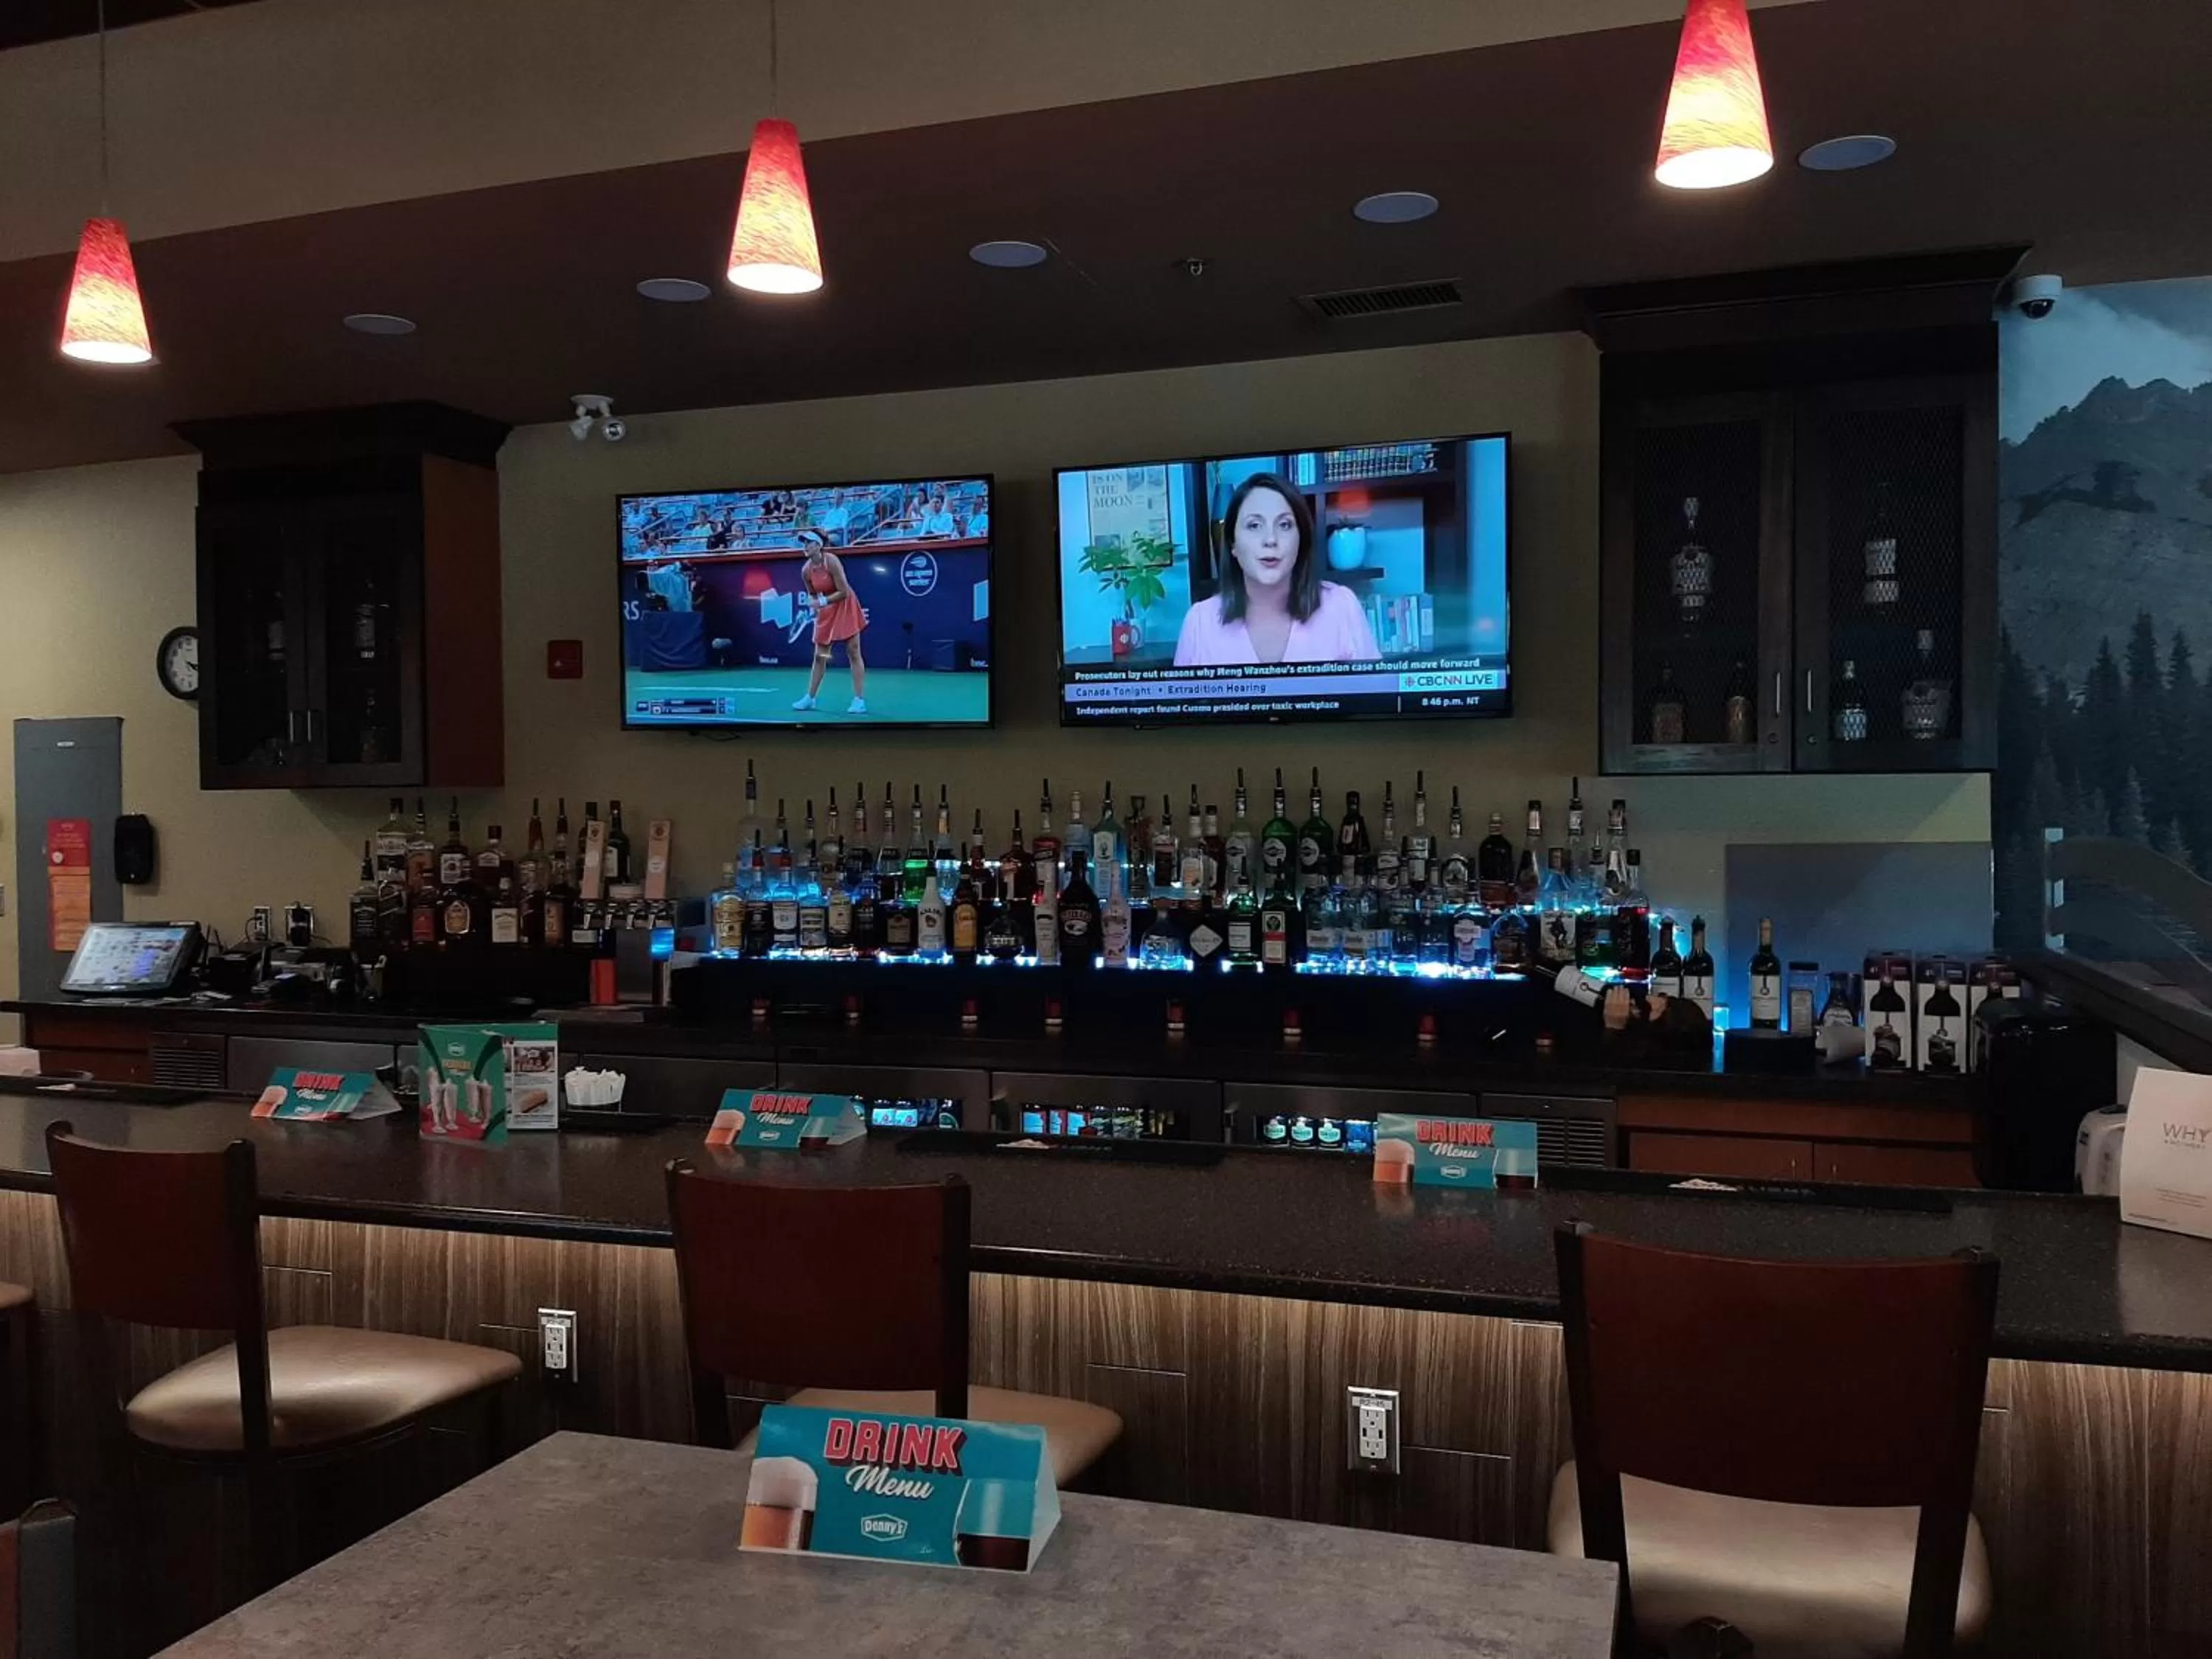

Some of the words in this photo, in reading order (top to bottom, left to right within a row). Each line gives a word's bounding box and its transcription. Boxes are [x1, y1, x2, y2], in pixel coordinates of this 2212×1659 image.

[1095, 484, 1119, 495] THE
[1093, 495, 1133, 507] MOON
[1075, 671, 1126, 680] Prosecutors
[1143, 669, 1158, 678] out
[1160, 669, 1194, 678] reasons
[1197, 667, 1215, 678] why
[1298, 663, 1349, 673] extradition
[1352, 663, 1373, 672] case
[1375, 661, 1408, 670] should
[1411, 661, 1437, 669] move
[1439, 658, 1480, 668] forward
[1465, 673, 1492, 685] LIVE
[1077, 687, 1110, 697] Canada
[1113, 686, 1151, 697] Tonight
[1168, 684, 1223, 695] Extradition
[1226, 683, 1266, 693] Hearing
[1077, 706, 1127, 716] Independent
[1130, 705, 1154, 714] report
[1156, 703, 1180, 713] found
[1294, 700, 1339, 711] workplace
[750, 1094, 812, 1115] DRINK
[757, 1112, 795, 1124] Menu
[1416, 1120, 1492, 1147] DRINK
[2163, 1122, 2212, 1143] WHY
[1429, 1143, 1480, 1158] Menu
[824, 1418, 964, 1473] DRINK
[845, 1464, 934, 1499] Menu
[865, 1519, 904, 1535] Denny's
